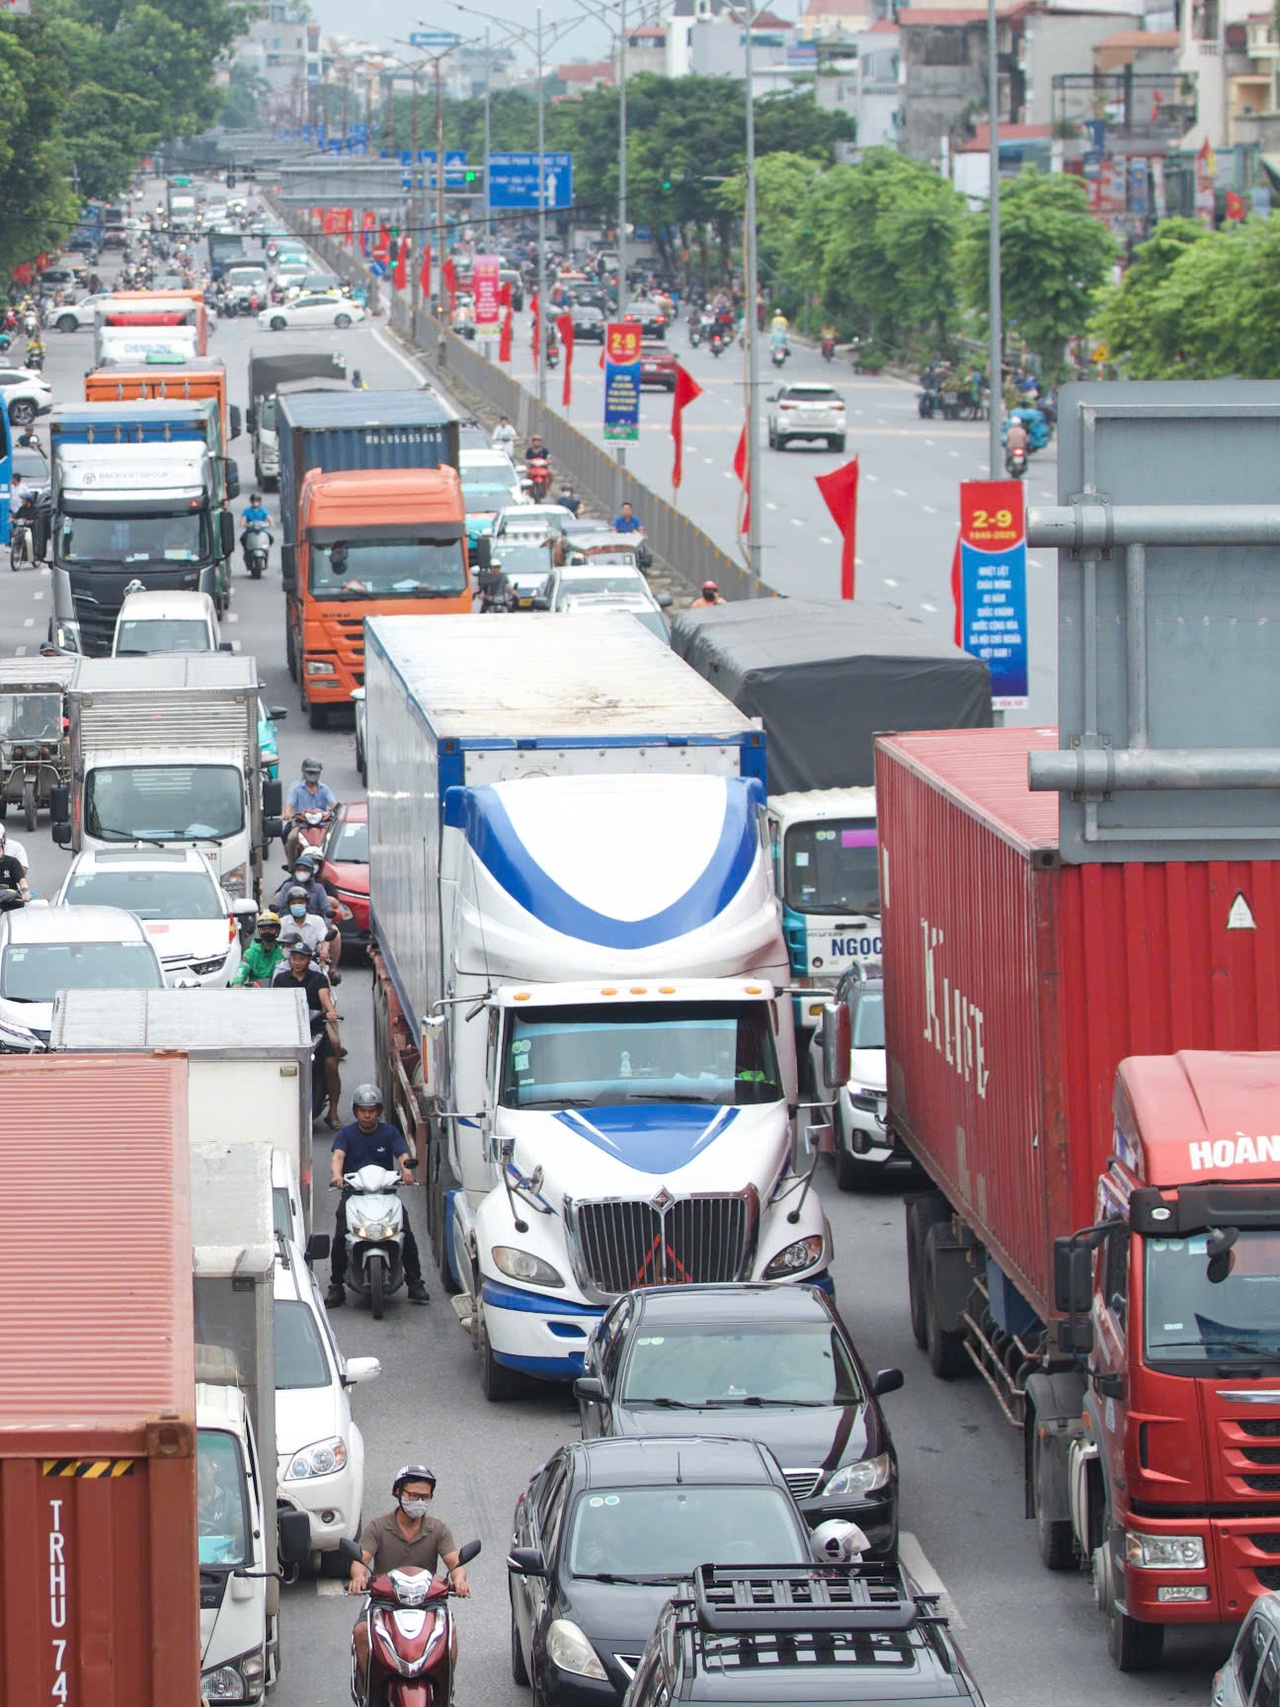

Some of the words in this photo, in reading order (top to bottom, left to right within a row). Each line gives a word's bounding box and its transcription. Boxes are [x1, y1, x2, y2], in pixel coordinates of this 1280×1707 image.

[972, 509, 1013, 528] 2-9
[49, 1500, 66, 1628] TRHU
[51, 1639, 68, 1707] 74
